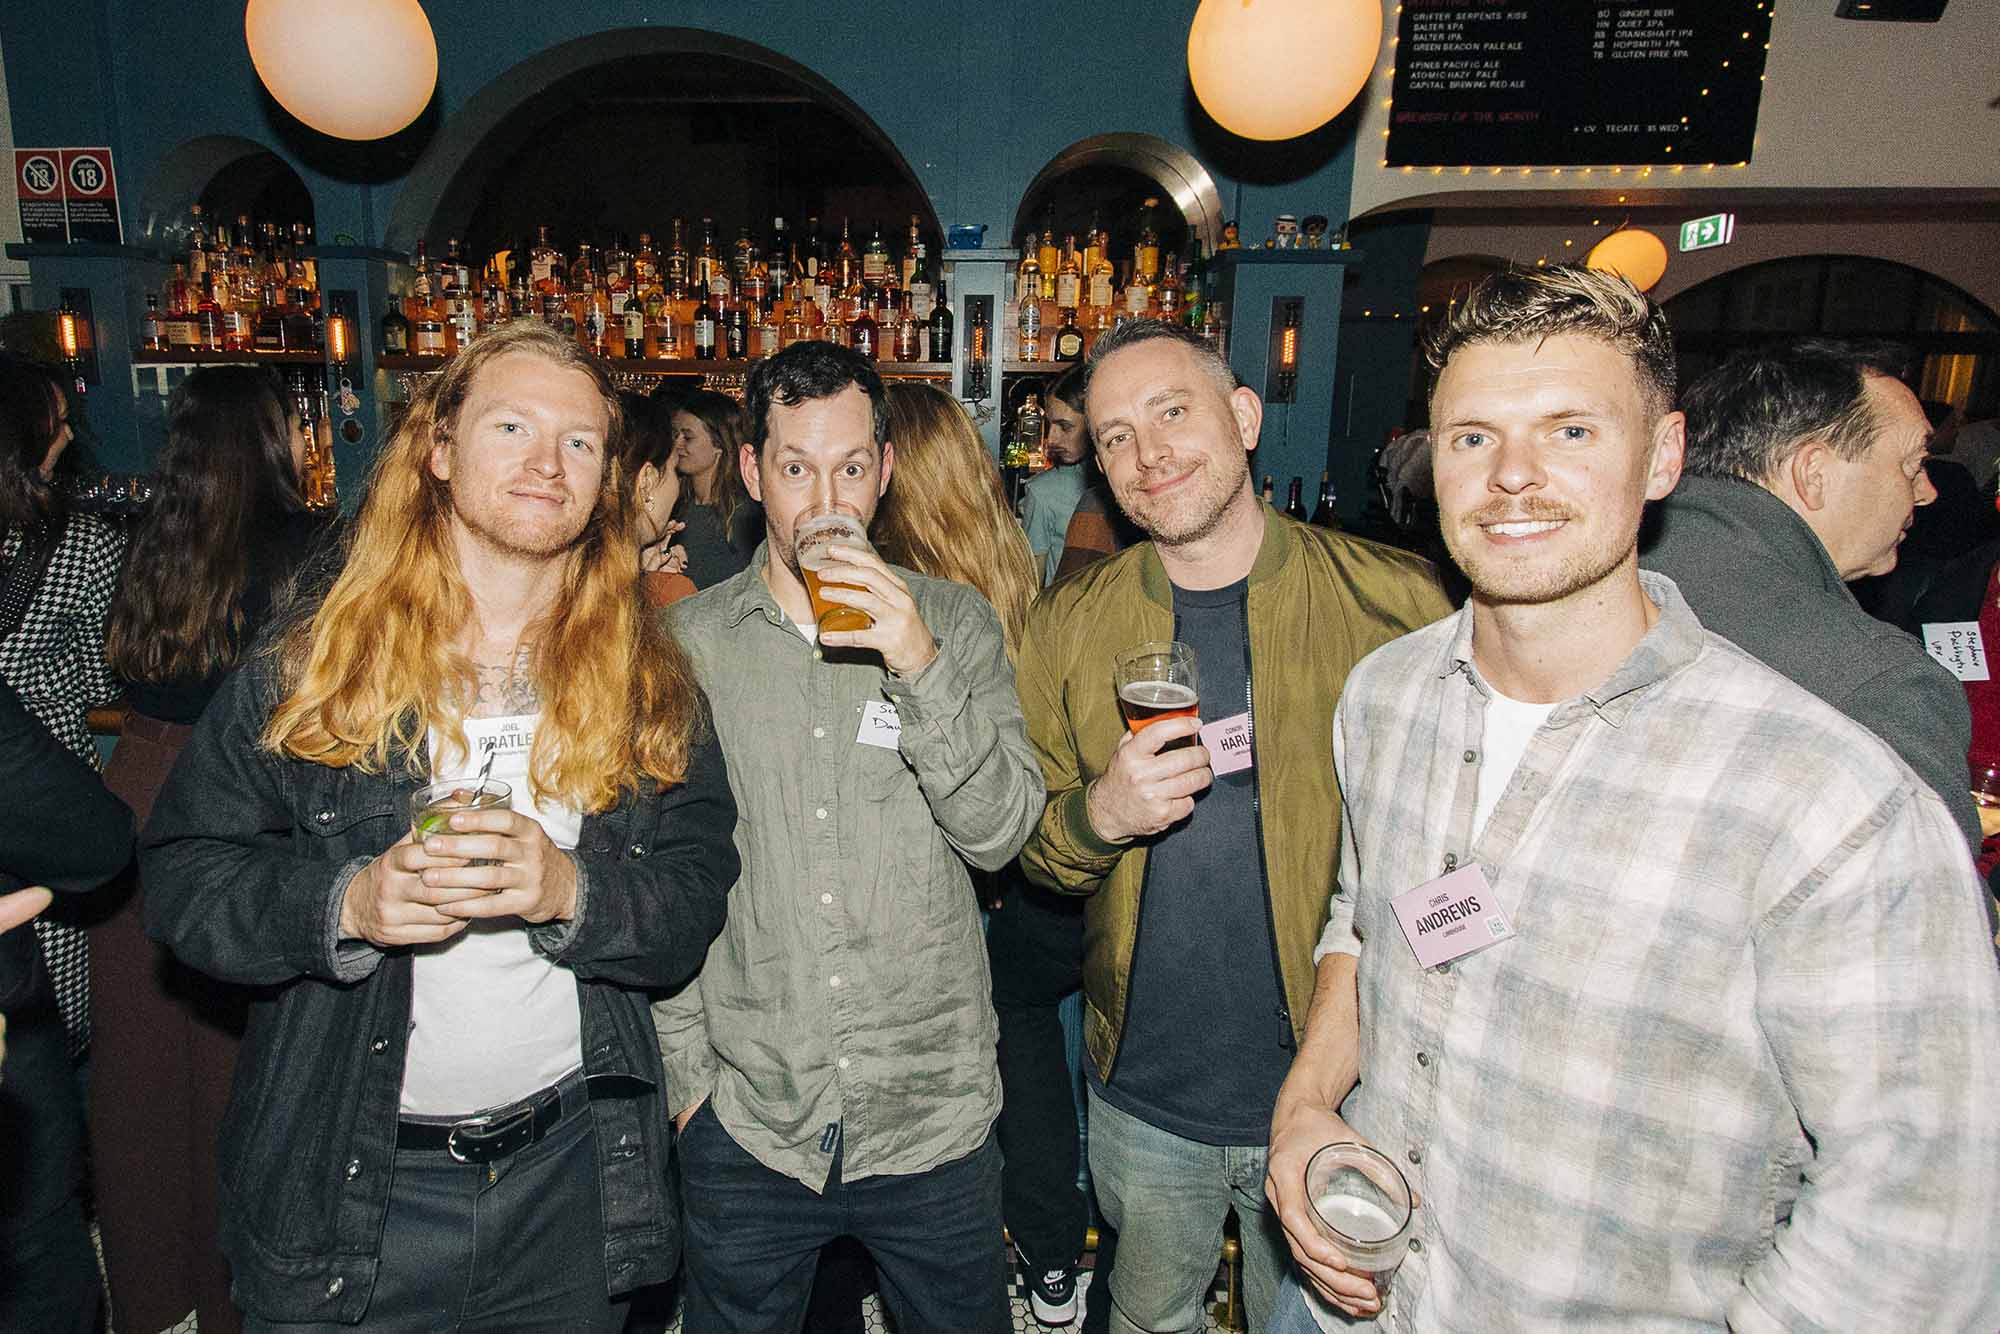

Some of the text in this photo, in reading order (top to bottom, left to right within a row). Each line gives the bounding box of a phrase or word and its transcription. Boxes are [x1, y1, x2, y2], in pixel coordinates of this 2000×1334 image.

[1456, 12, 1502, 20] SERPENTS
[1413, 23, 1445, 31] BALTER
[1412, 32, 1462, 41] BALTER IPA
[1412, 42, 1523, 51] GREEN BEACON PALE ALE
[1442, 61, 1481, 69] PACIFIC
[1483, 60, 1501, 69] ALE
[1410, 71, 1446, 79] ATOMIC
[1475, 70, 1498, 79] PALE
[1409, 81, 1445, 89] CAPITAL
[1489, 80, 1508, 88] RED
[1509, 80, 1527, 88] ALE
[1605, 124, 1640, 133] TECATE
[77, 169, 97, 187] 18
[1428, 893, 1449, 908] CHRIS
[1415, 895, 1481, 936] ANDREWS
